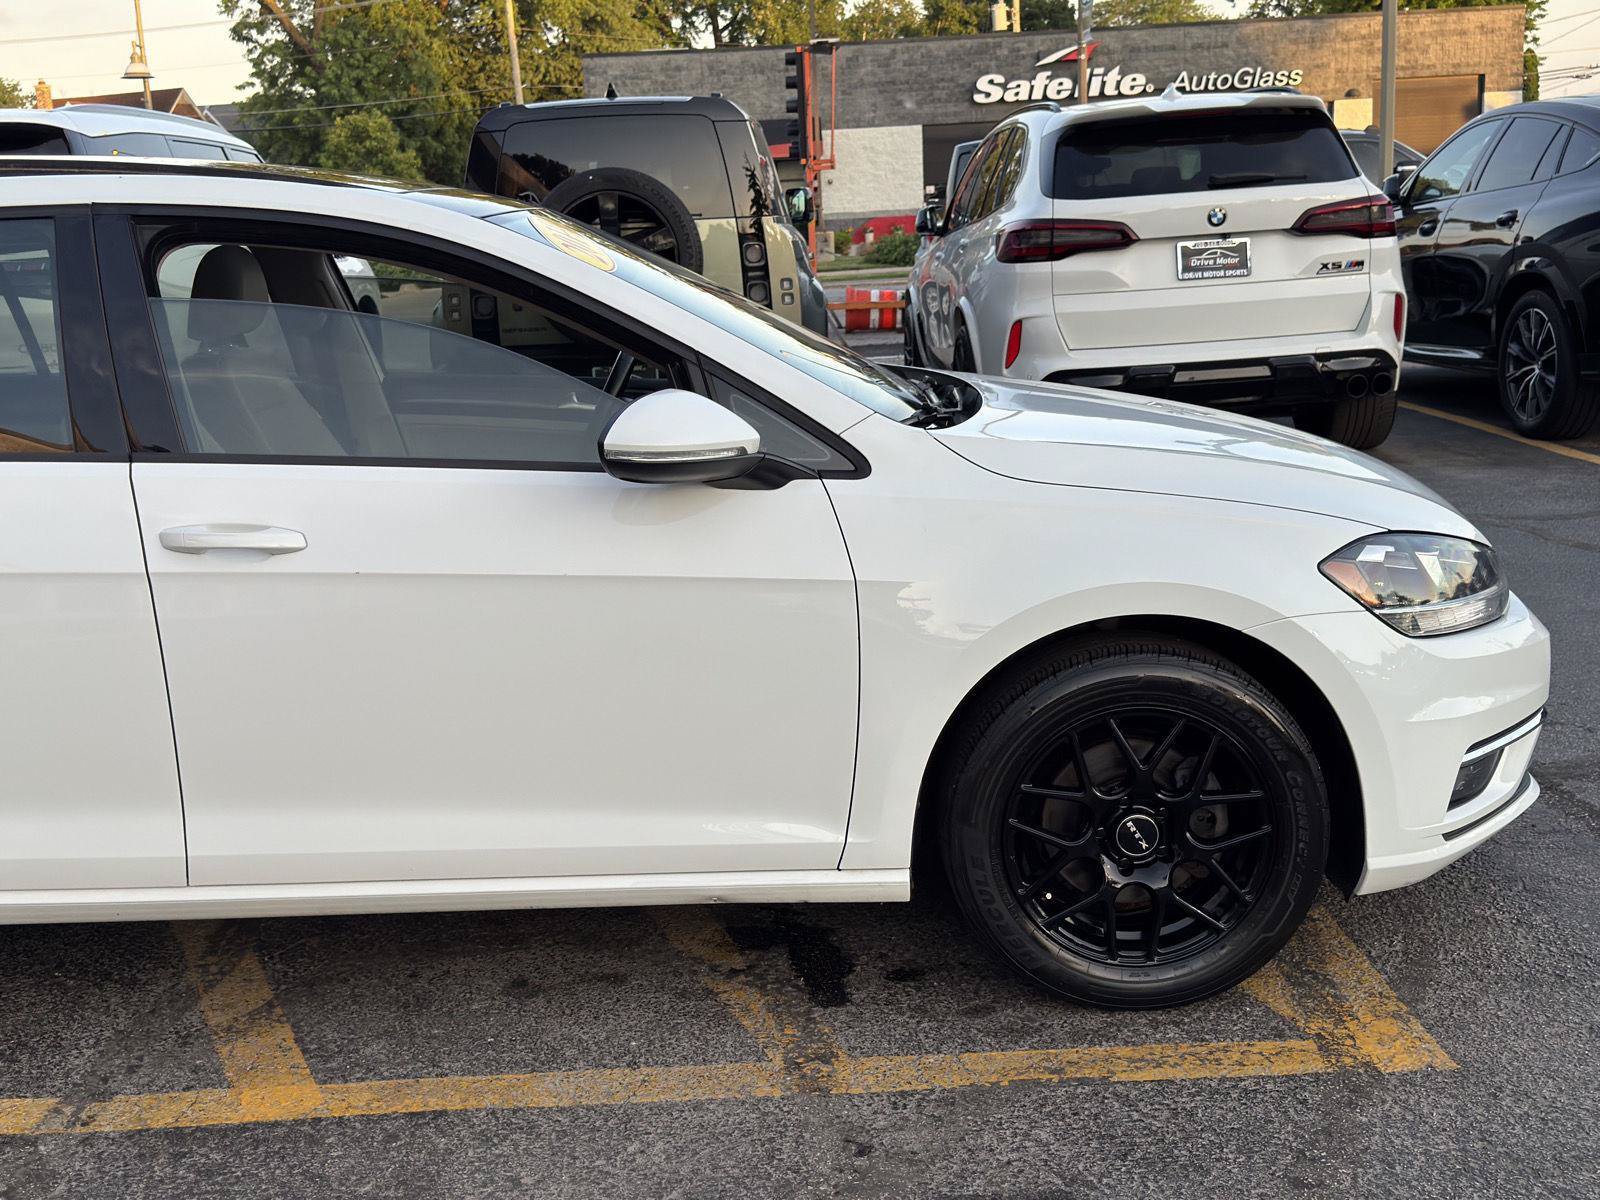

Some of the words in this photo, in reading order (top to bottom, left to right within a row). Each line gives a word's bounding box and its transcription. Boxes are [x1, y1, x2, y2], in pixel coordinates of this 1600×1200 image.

[1174, 66, 1303, 92] AutoGlass
[1191, 258, 1214, 267] Drive
[1216, 256, 1240, 265] Motor
[1320, 261, 1342, 270] X5
[1203, 270, 1225, 278] MOTOR
[1126, 821, 1149, 850] RTX
[968, 839, 1041, 966] HERCULE
